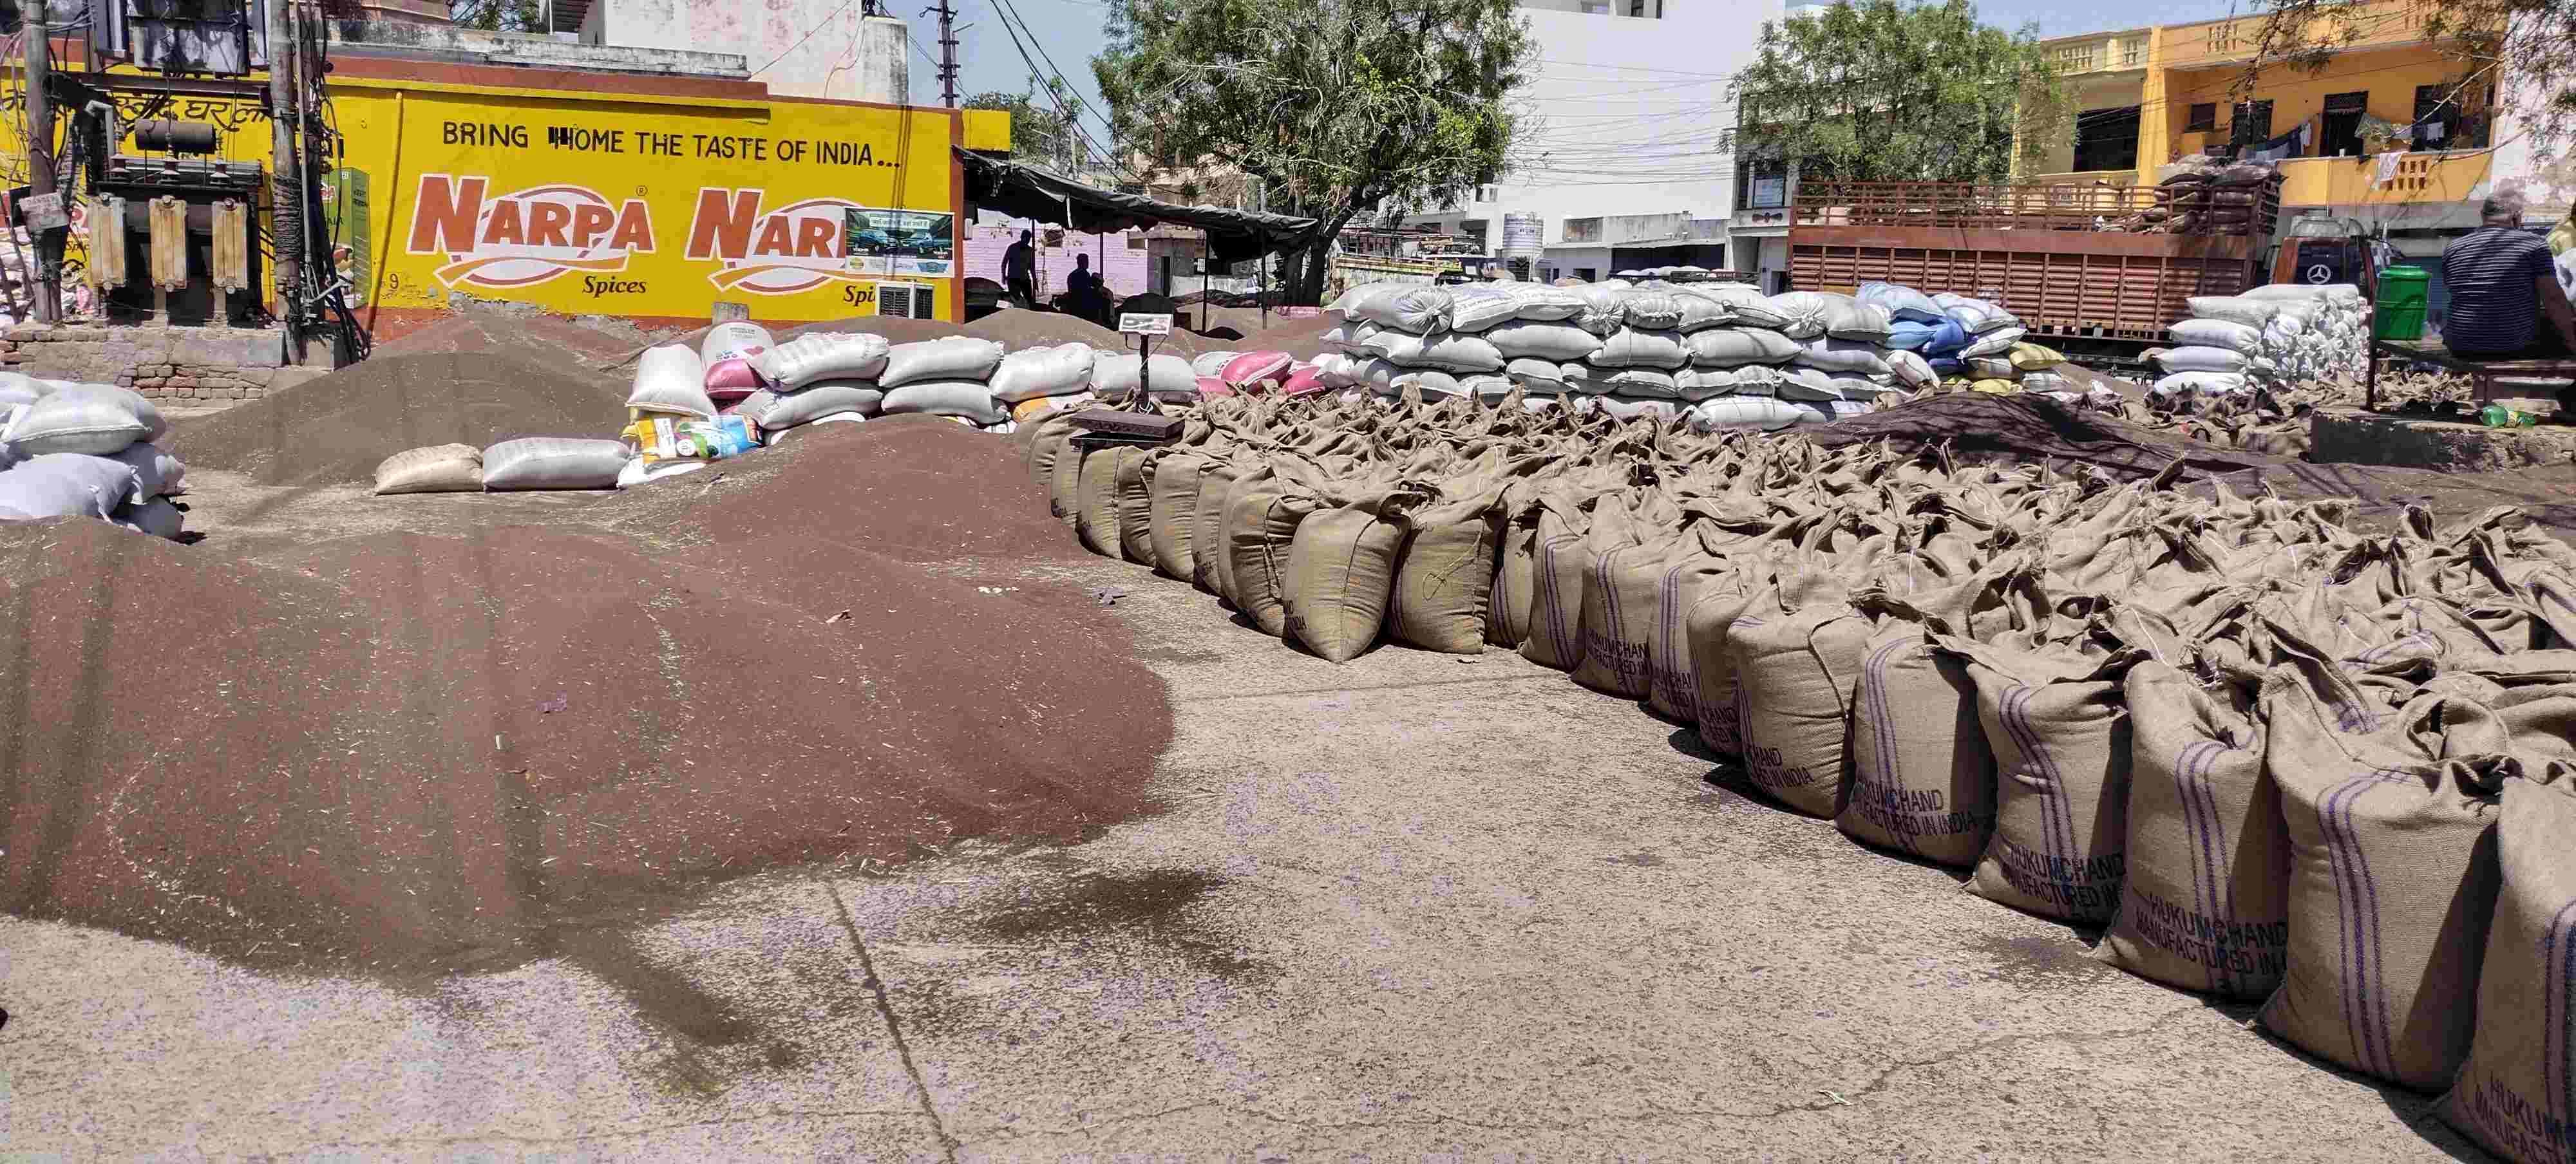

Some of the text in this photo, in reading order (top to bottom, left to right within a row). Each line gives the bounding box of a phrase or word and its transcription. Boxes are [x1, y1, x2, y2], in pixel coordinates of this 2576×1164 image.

[442, 121, 529, 148] BRING
[547, 126, 624, 153] HOME
[635, 131, 683, 156] THE
[692, 135, 767, 160] TASTE
[777, 140, 808, 162] OF
[406, 174, 656, 254] NARPA
[684, 187, 845, 260] NAR
[582, 276, 647, 298] Spices
[843, 285, 876, 306] Spi
[1922, 814, 1938, 836] IN
[2135, 906, 2256, 973] MANUFACTURED
[2257, 951, 2279, 975] IN
